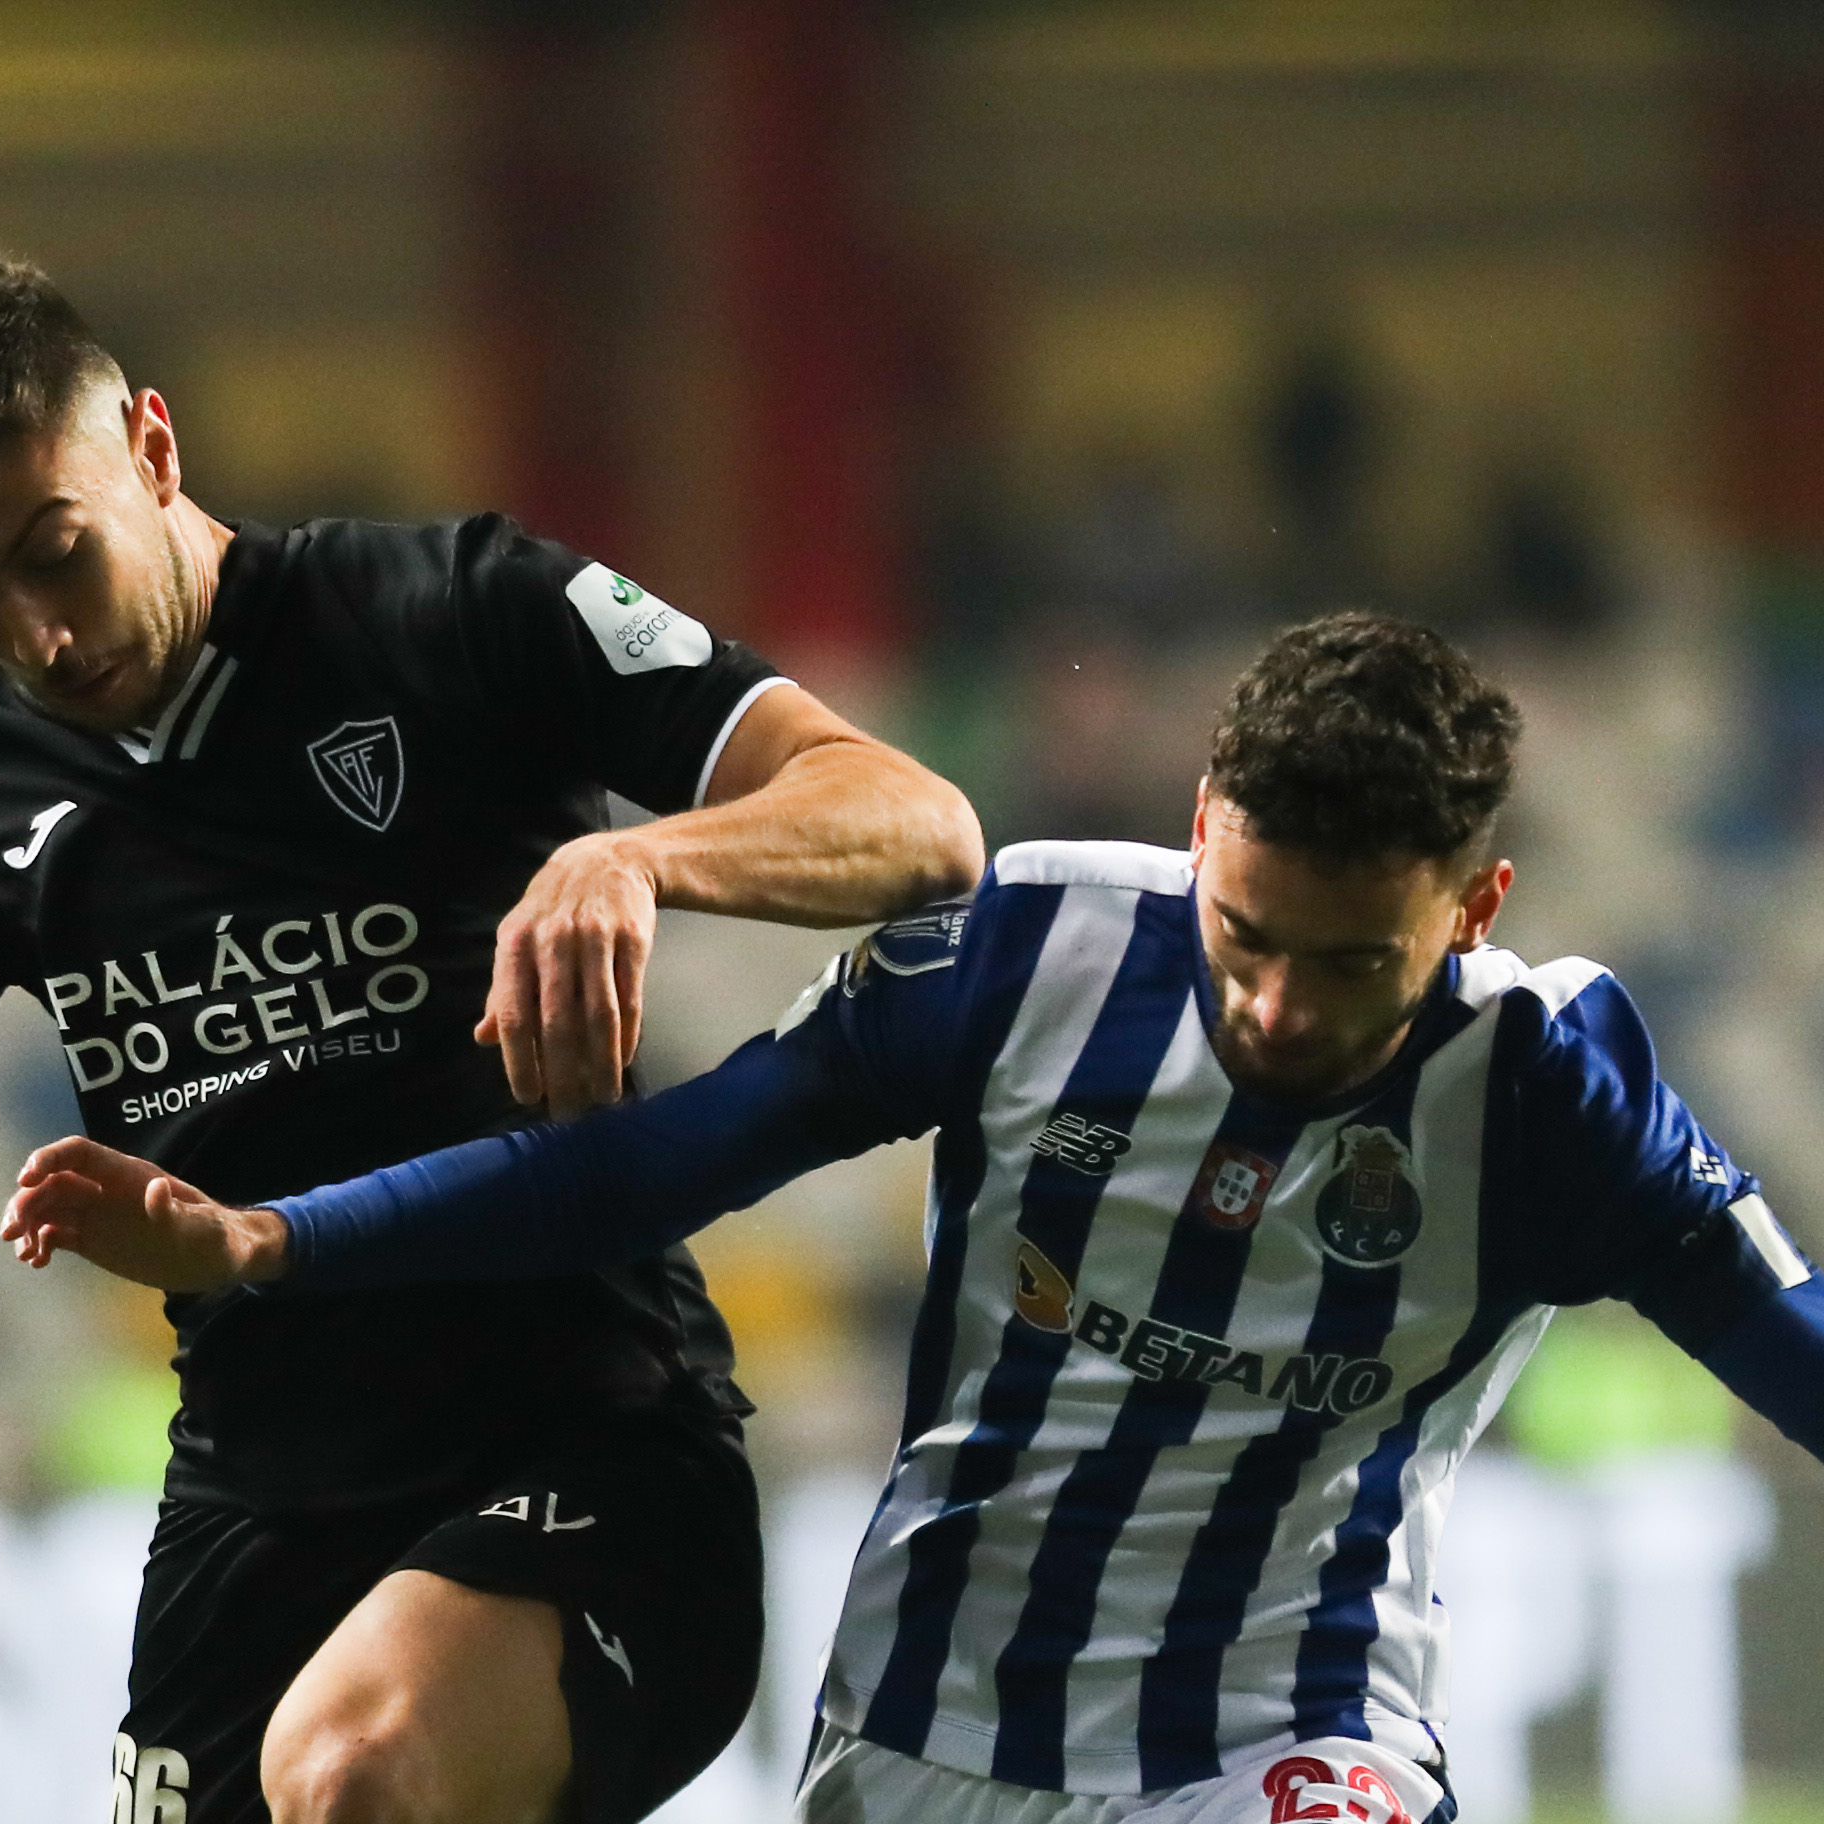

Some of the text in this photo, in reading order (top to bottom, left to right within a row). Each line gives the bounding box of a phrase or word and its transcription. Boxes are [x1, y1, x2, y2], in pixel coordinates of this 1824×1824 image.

[43, 903, 419, 1031] PALÁCIO
[63, 963, 430, 1093] DO GELO
[121, 1028, 402, 1125] SHOPPING VISEU
[1075, 1299, 1395, 1416] BETANO
